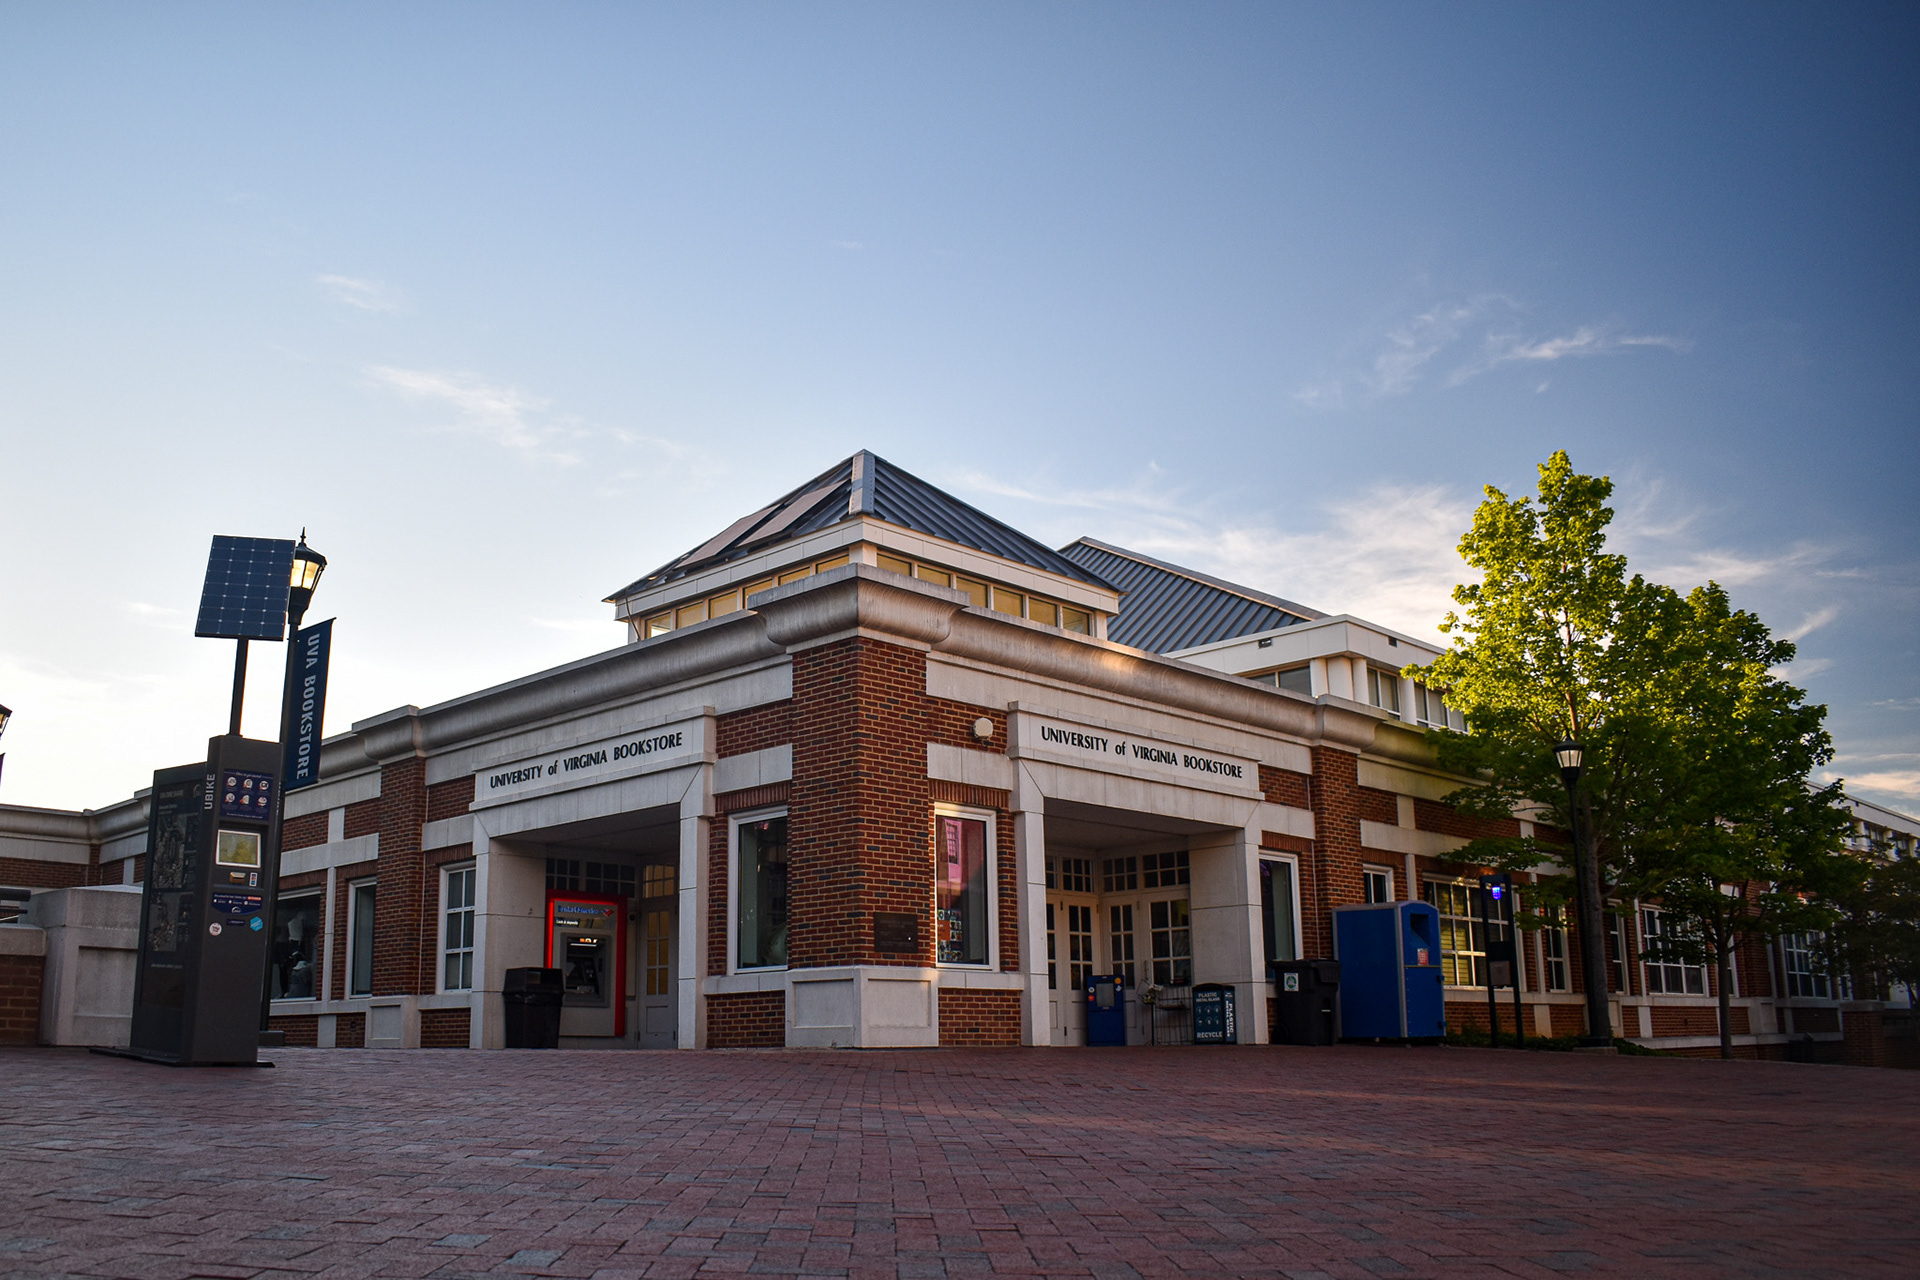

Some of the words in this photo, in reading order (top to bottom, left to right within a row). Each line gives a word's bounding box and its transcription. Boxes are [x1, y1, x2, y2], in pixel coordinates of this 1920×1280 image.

[306, 633, 320, 669] UVA
[296, 674, 316, 780] BOOKSTORE
[1041, 725, 1109, 752] UNIVERSITY
[1115, 741, 1126, 756] of
[1132, 744, 1178, 766] VIRGINIA
[1183, 755, 1243, 779] BOOKSTORE
[490, 764, 543, 789] UNIVERSITY
[548, 760, 558, 776] of
[563, 749, 608, 772] VIRGINIA
[613, 732, 682, 761] BOOKSTORE
[204, 773, 216, 810] UBIKE
